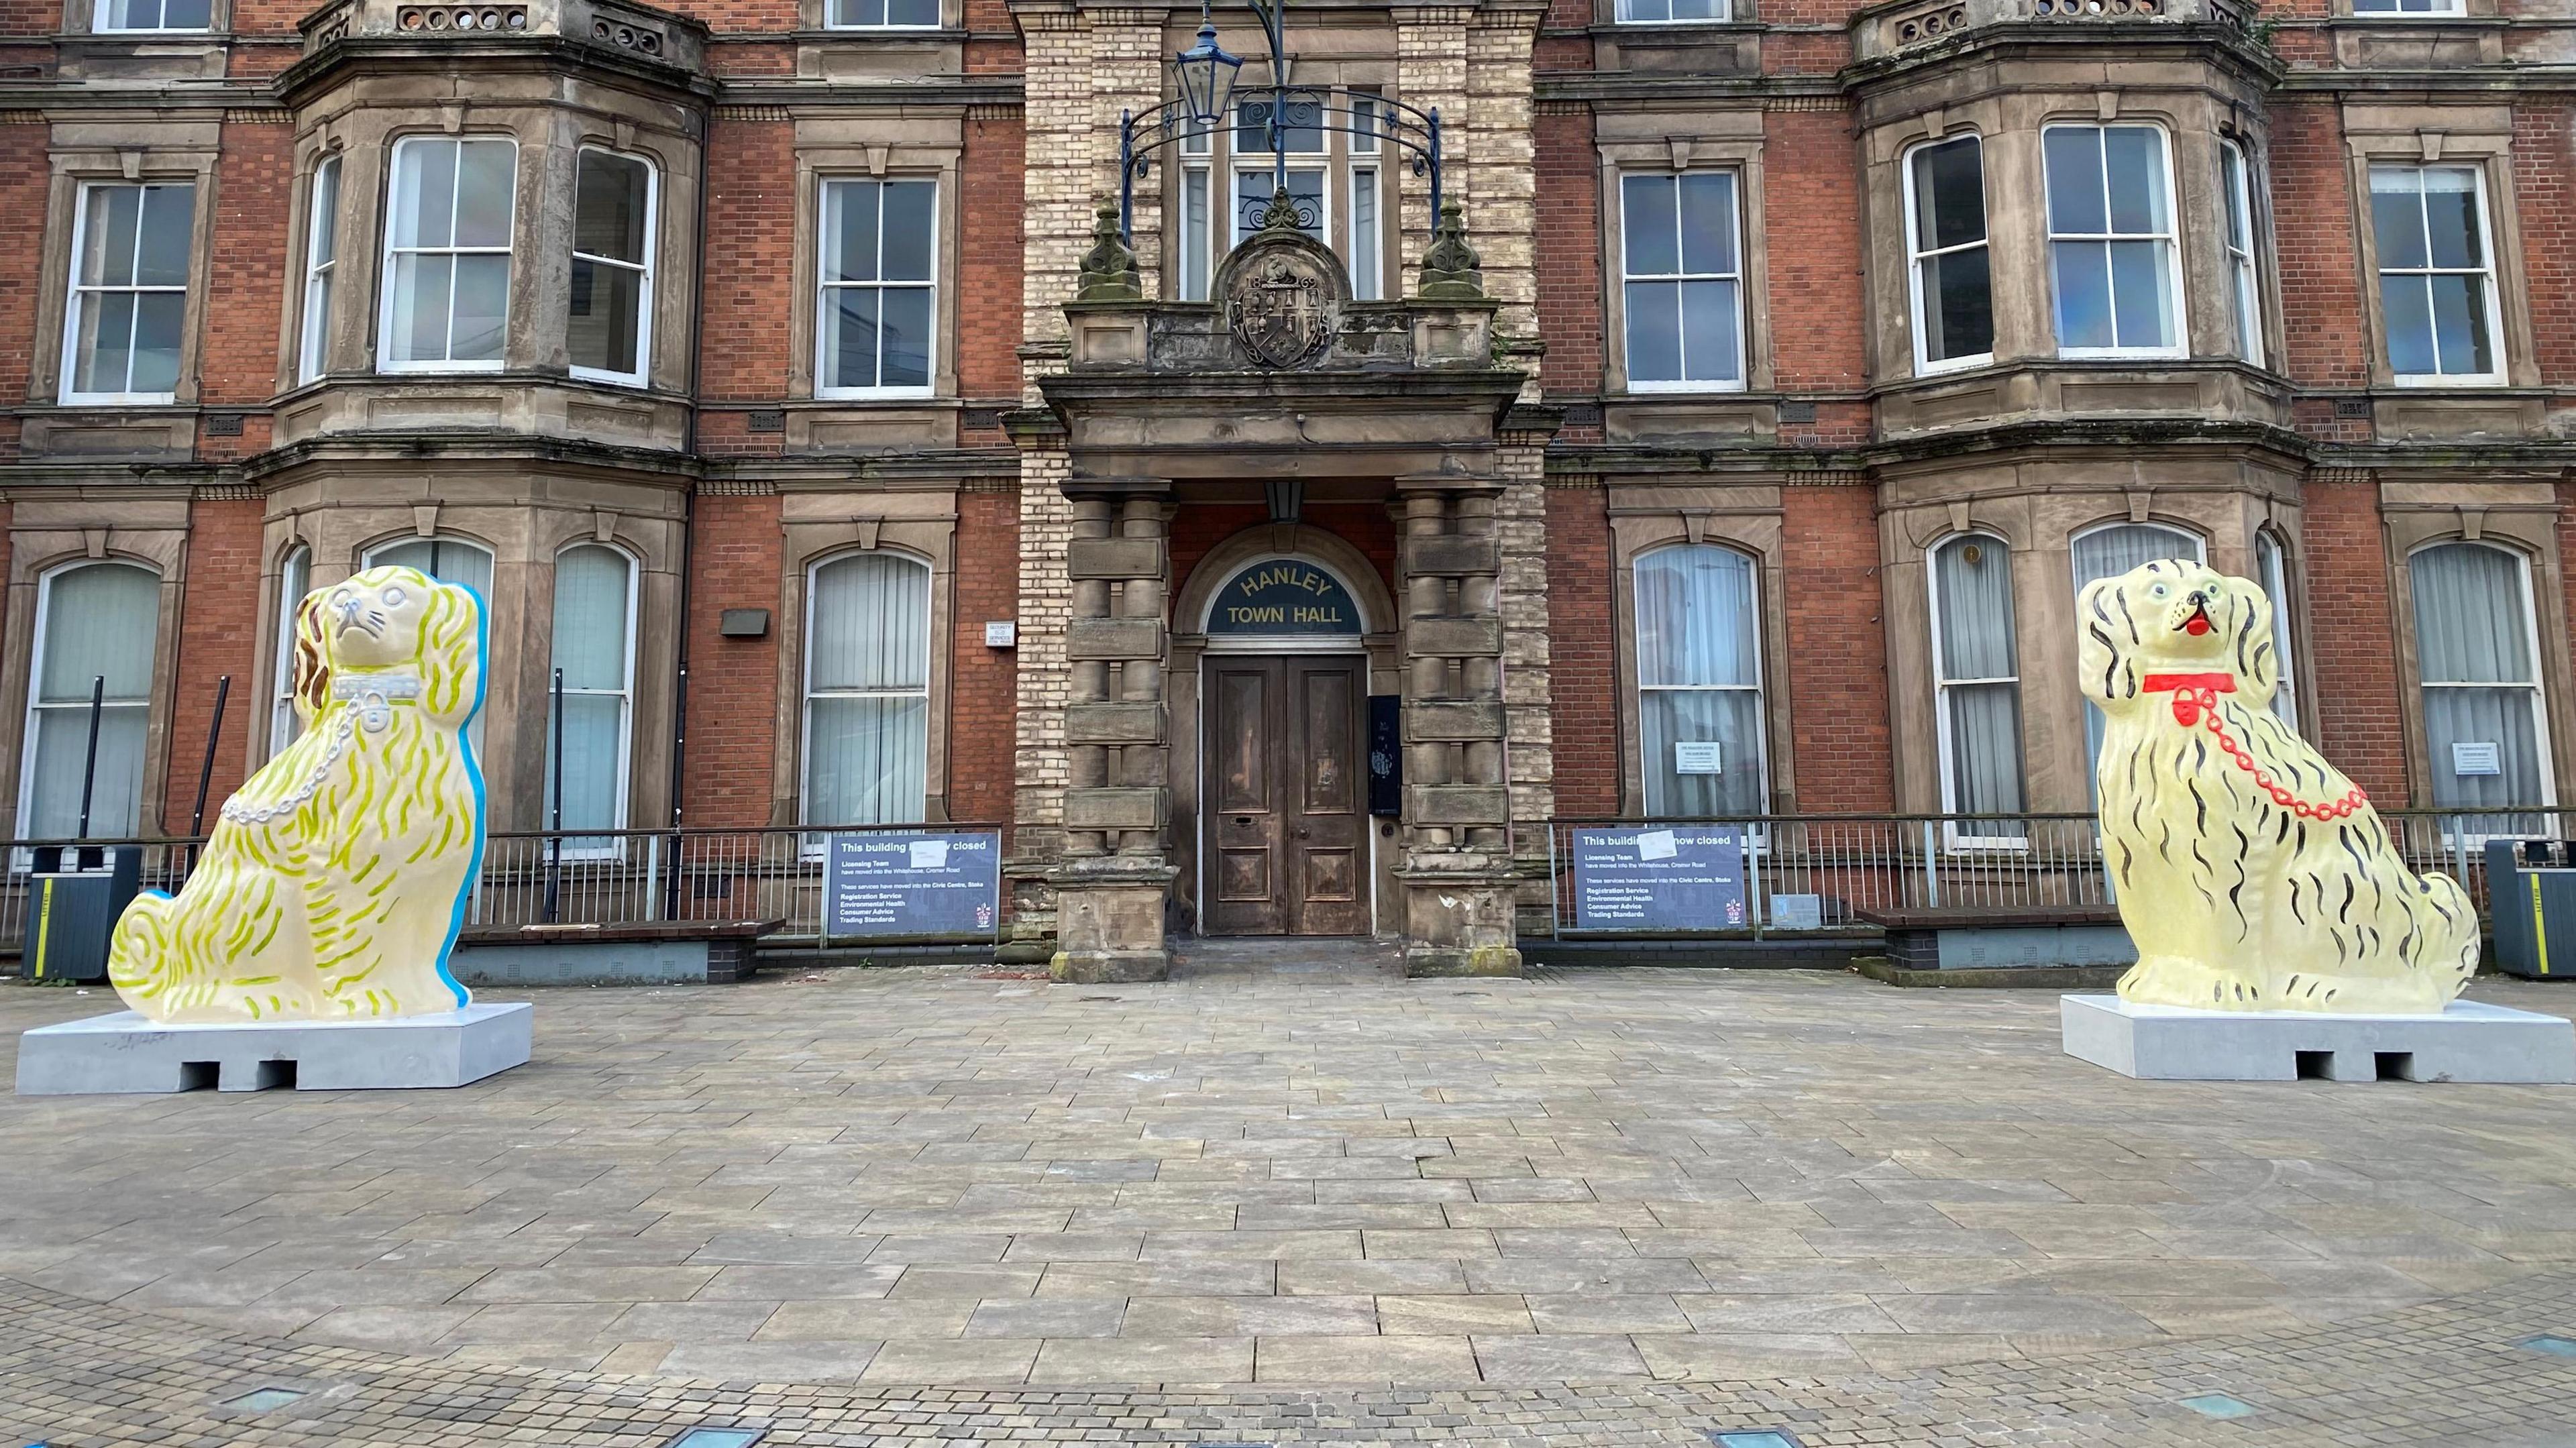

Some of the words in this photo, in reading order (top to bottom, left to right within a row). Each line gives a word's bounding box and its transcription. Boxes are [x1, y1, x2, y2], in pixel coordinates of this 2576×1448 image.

[1240, 567, 1332, 597] HANLEY
[1228, 607, 1284, 623] TOWN
[1294, 607, 1342, 623] HALL
[841, 843, 863, 852] This
[865, 842, 906, 853] building
[953, 841, 986, 850] closed
[1583, 836, 1605, 846] This
[1697, 836, 1730, 844] closed
